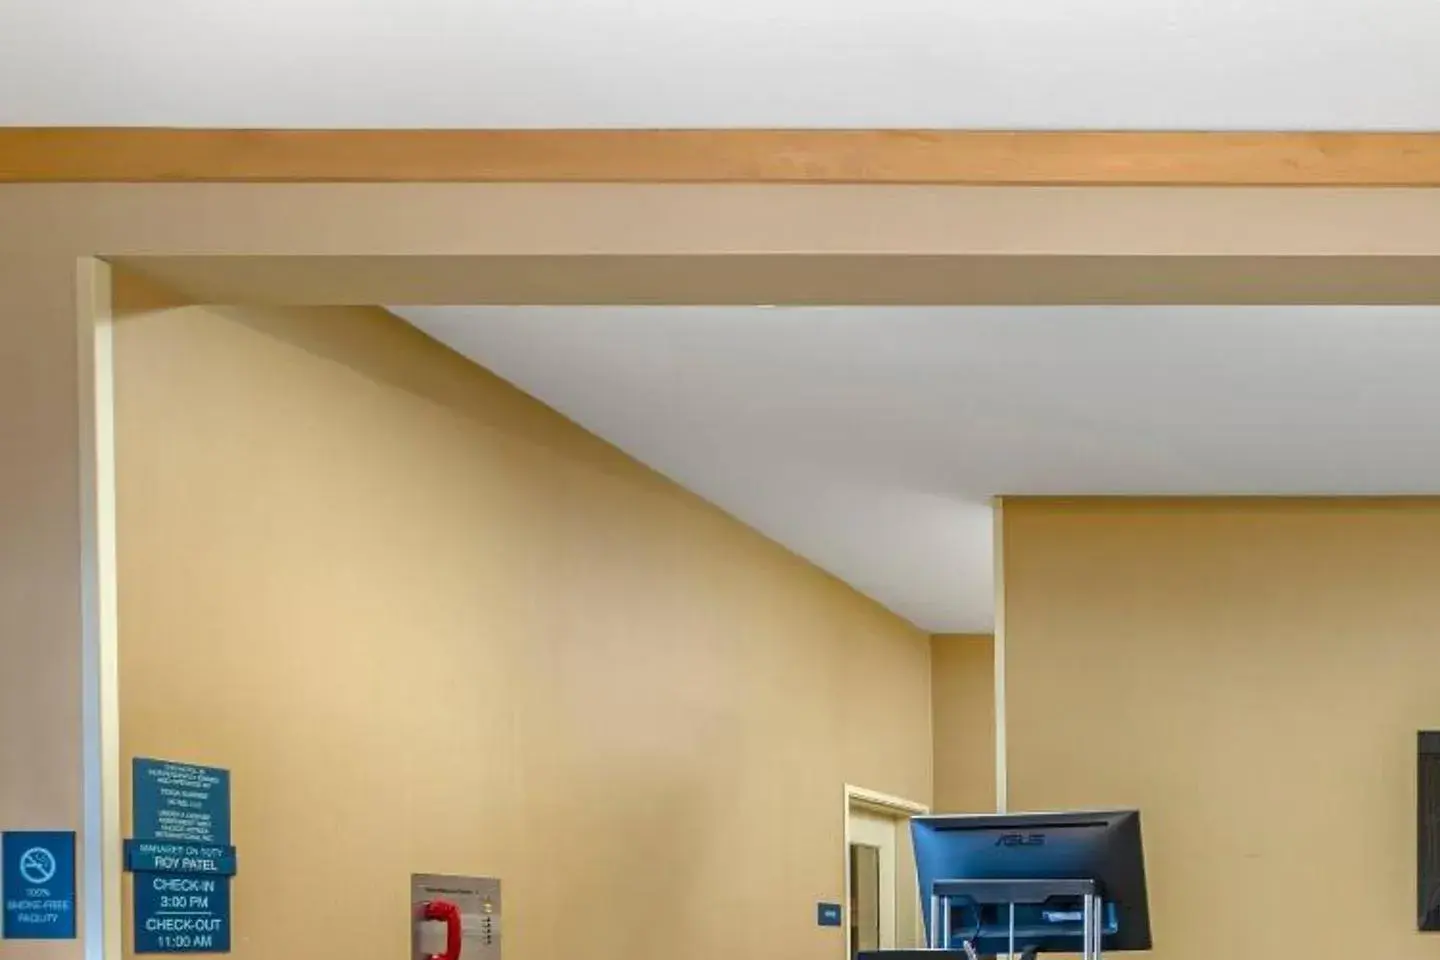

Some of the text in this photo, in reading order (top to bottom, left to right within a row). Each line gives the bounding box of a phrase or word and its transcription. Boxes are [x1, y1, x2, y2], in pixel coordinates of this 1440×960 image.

[155, 856, 216, 871] ROY PATEL
[161, 896, 209, 909] 3:00 PM
[145, 918, 222, 932] CHECK-OUT
[158, 935, 213, 948] 11:00 AM
